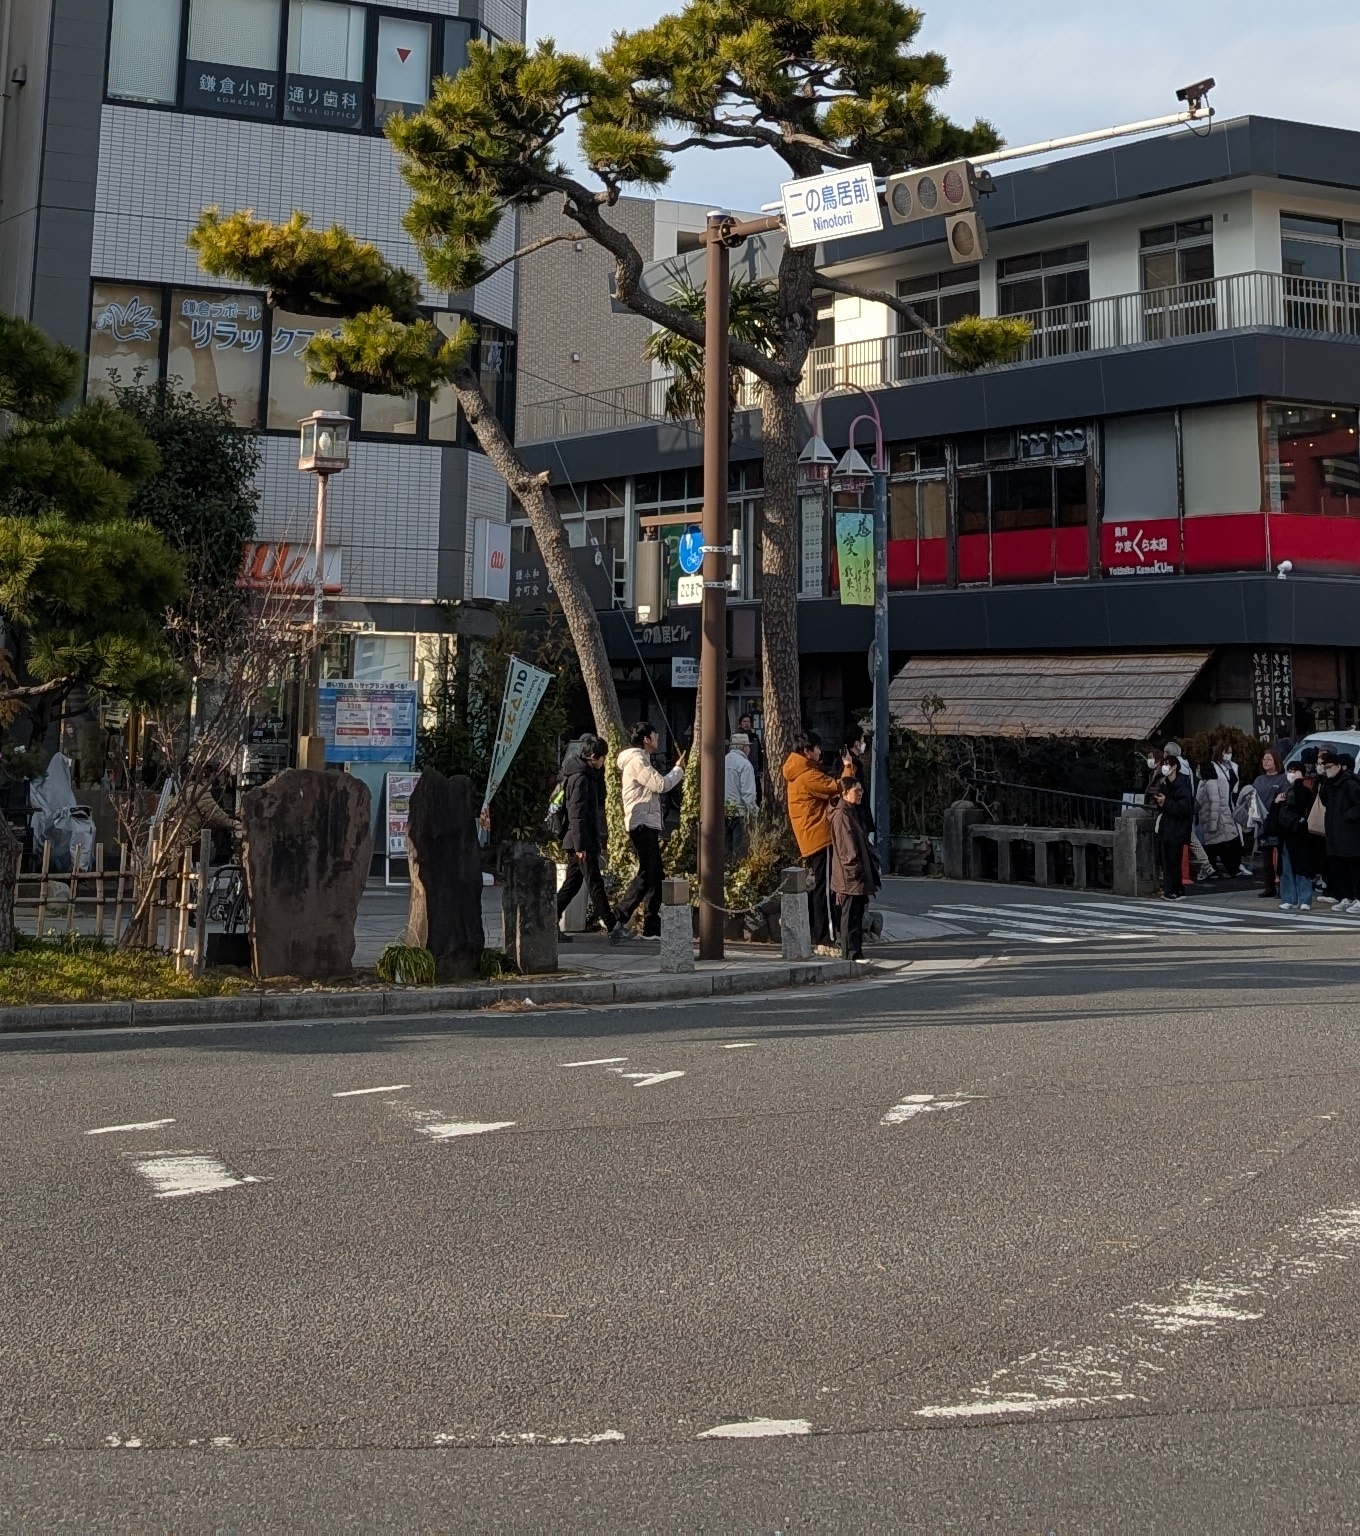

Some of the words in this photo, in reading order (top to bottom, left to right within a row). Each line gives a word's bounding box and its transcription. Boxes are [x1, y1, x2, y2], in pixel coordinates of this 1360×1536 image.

[790, 176, 870, 217] 二の鳥居前
[812, 210, 854, 232] Ninotorii
[1114, 529, 1168, 562] かまくら本店
[633, 624, 691, 644] 二の鳥居ビル
